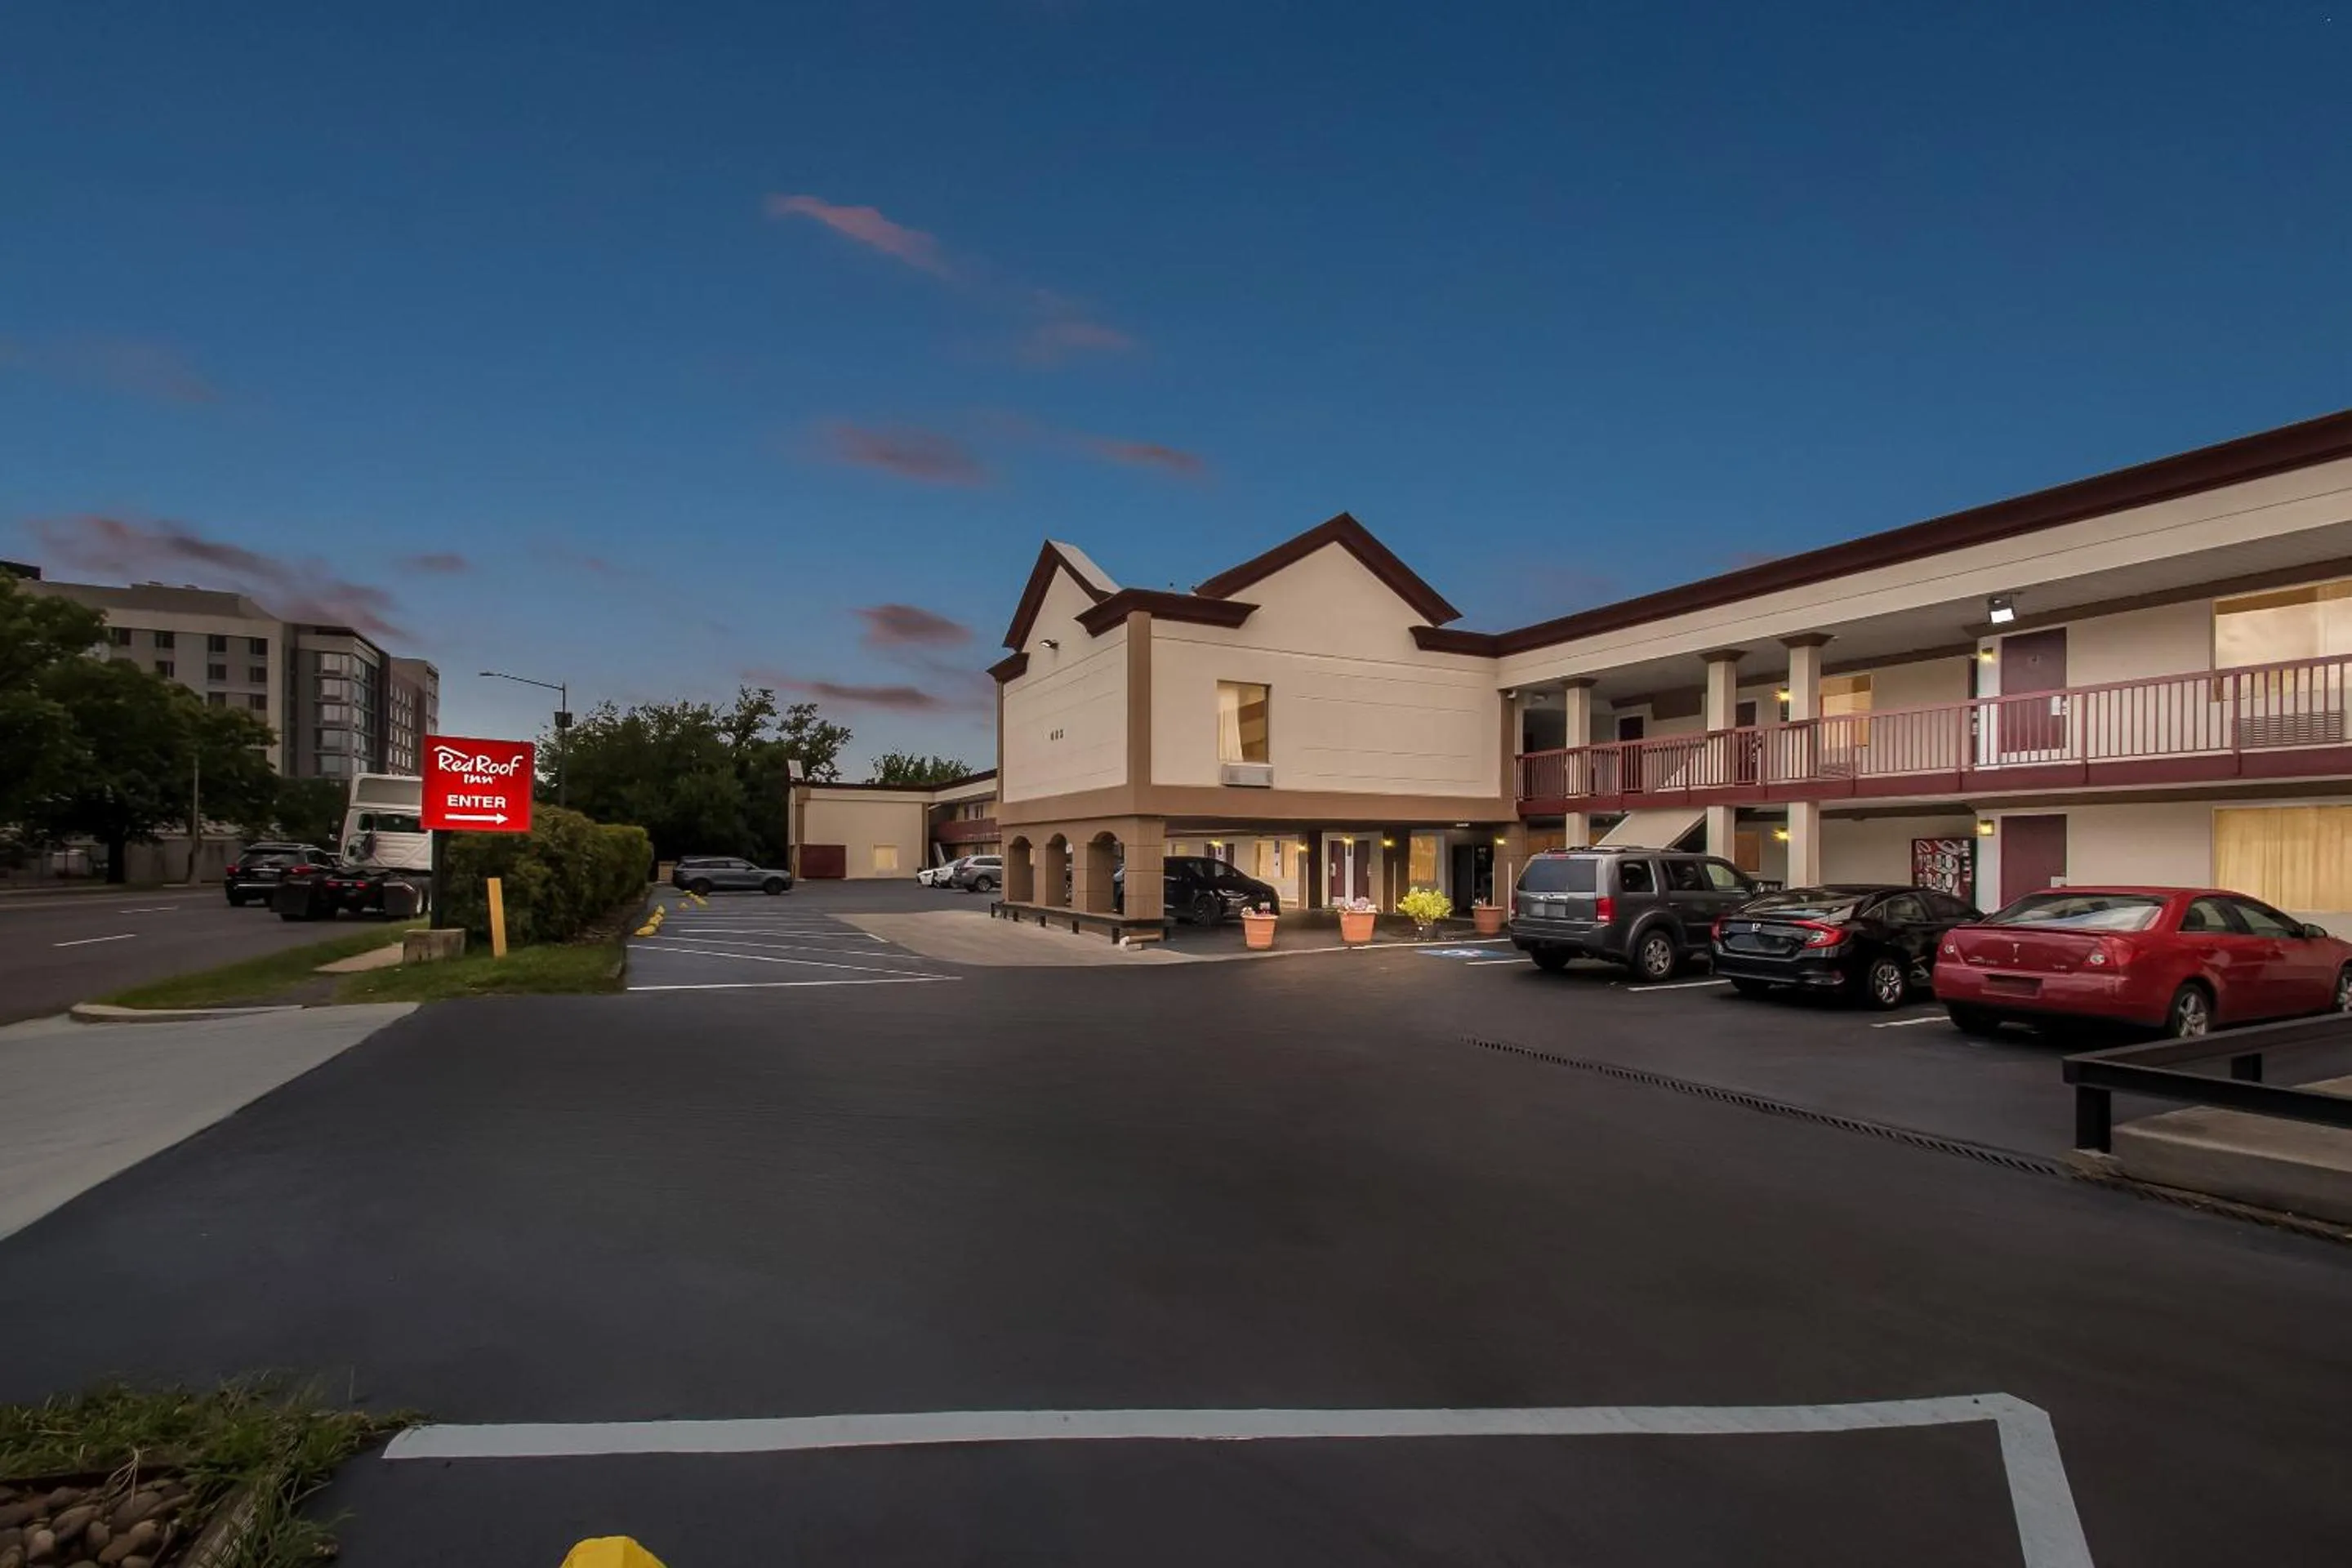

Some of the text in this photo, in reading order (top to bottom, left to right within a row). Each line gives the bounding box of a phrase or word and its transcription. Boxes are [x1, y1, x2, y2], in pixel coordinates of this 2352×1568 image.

[439, 752, 523, 777] Red Roof
[447, 795, 506, 808] ENTER
